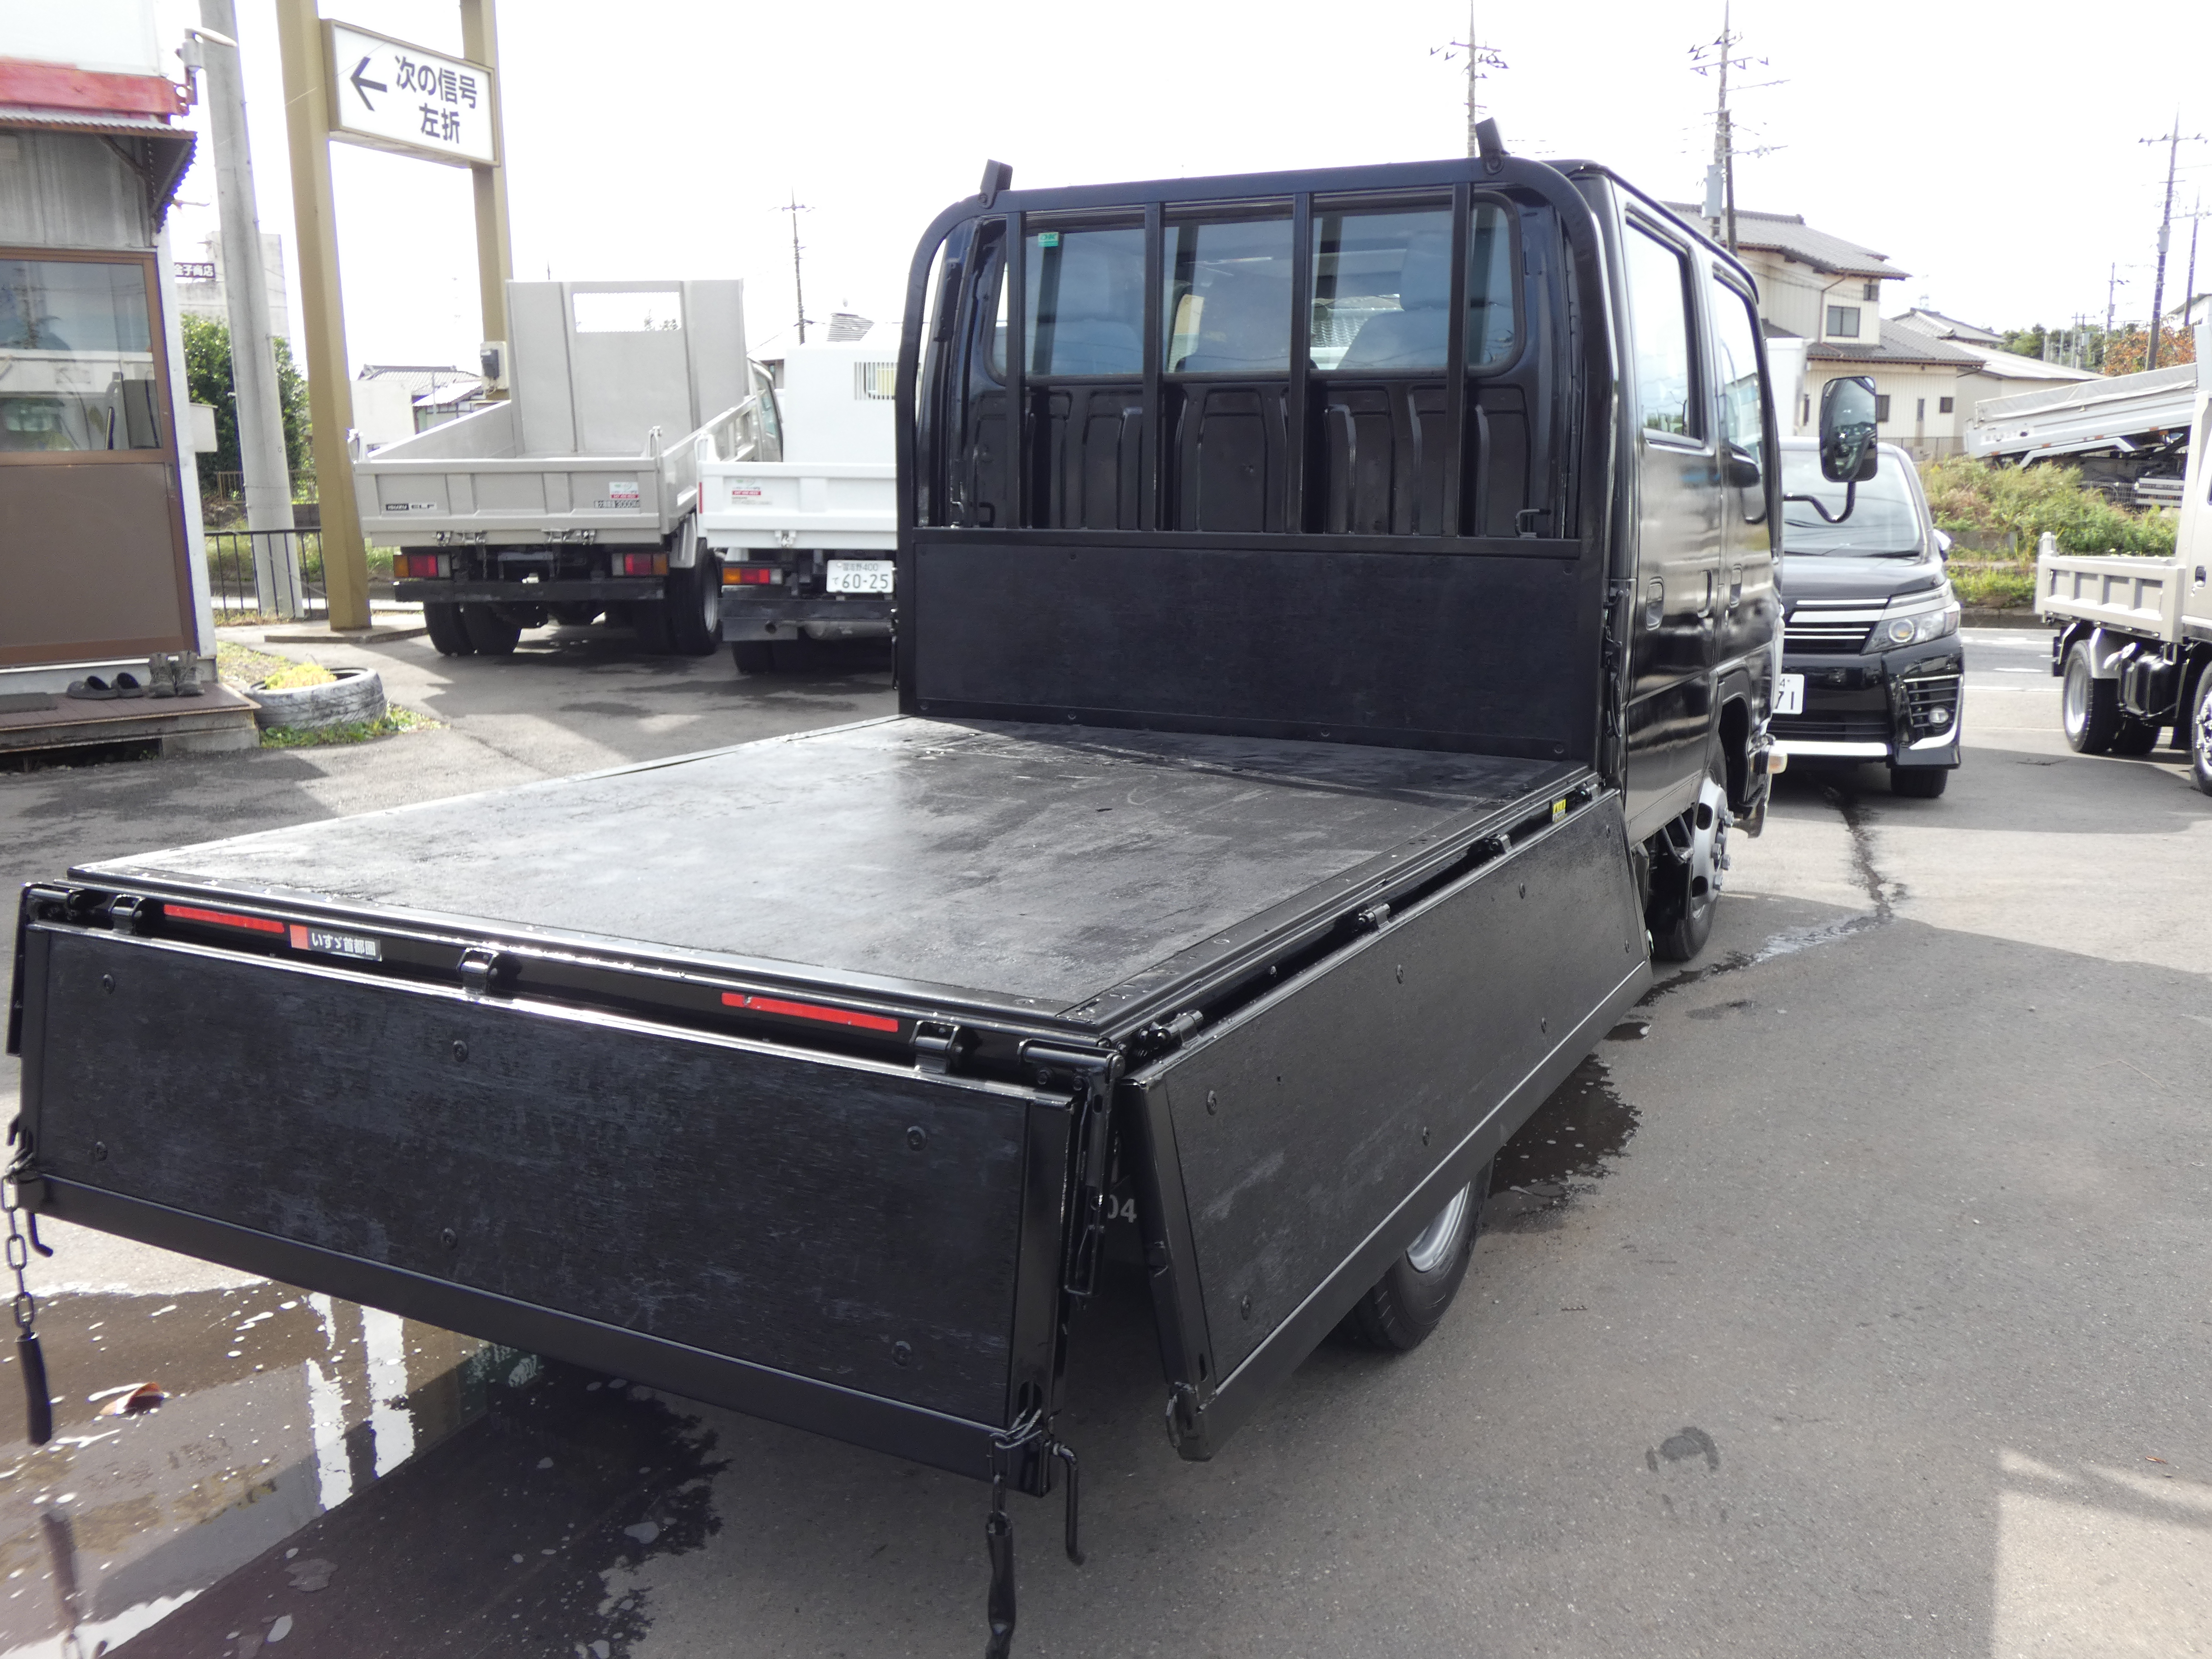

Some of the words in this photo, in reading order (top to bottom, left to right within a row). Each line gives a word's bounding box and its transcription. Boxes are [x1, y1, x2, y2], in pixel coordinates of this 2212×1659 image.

[395, 56, 477, 109] 次の信号
[419, 103, 460, 144] 左折
[174, 264, 214, 276] 金子商店
[842, 573, 889, 589] 60-25
